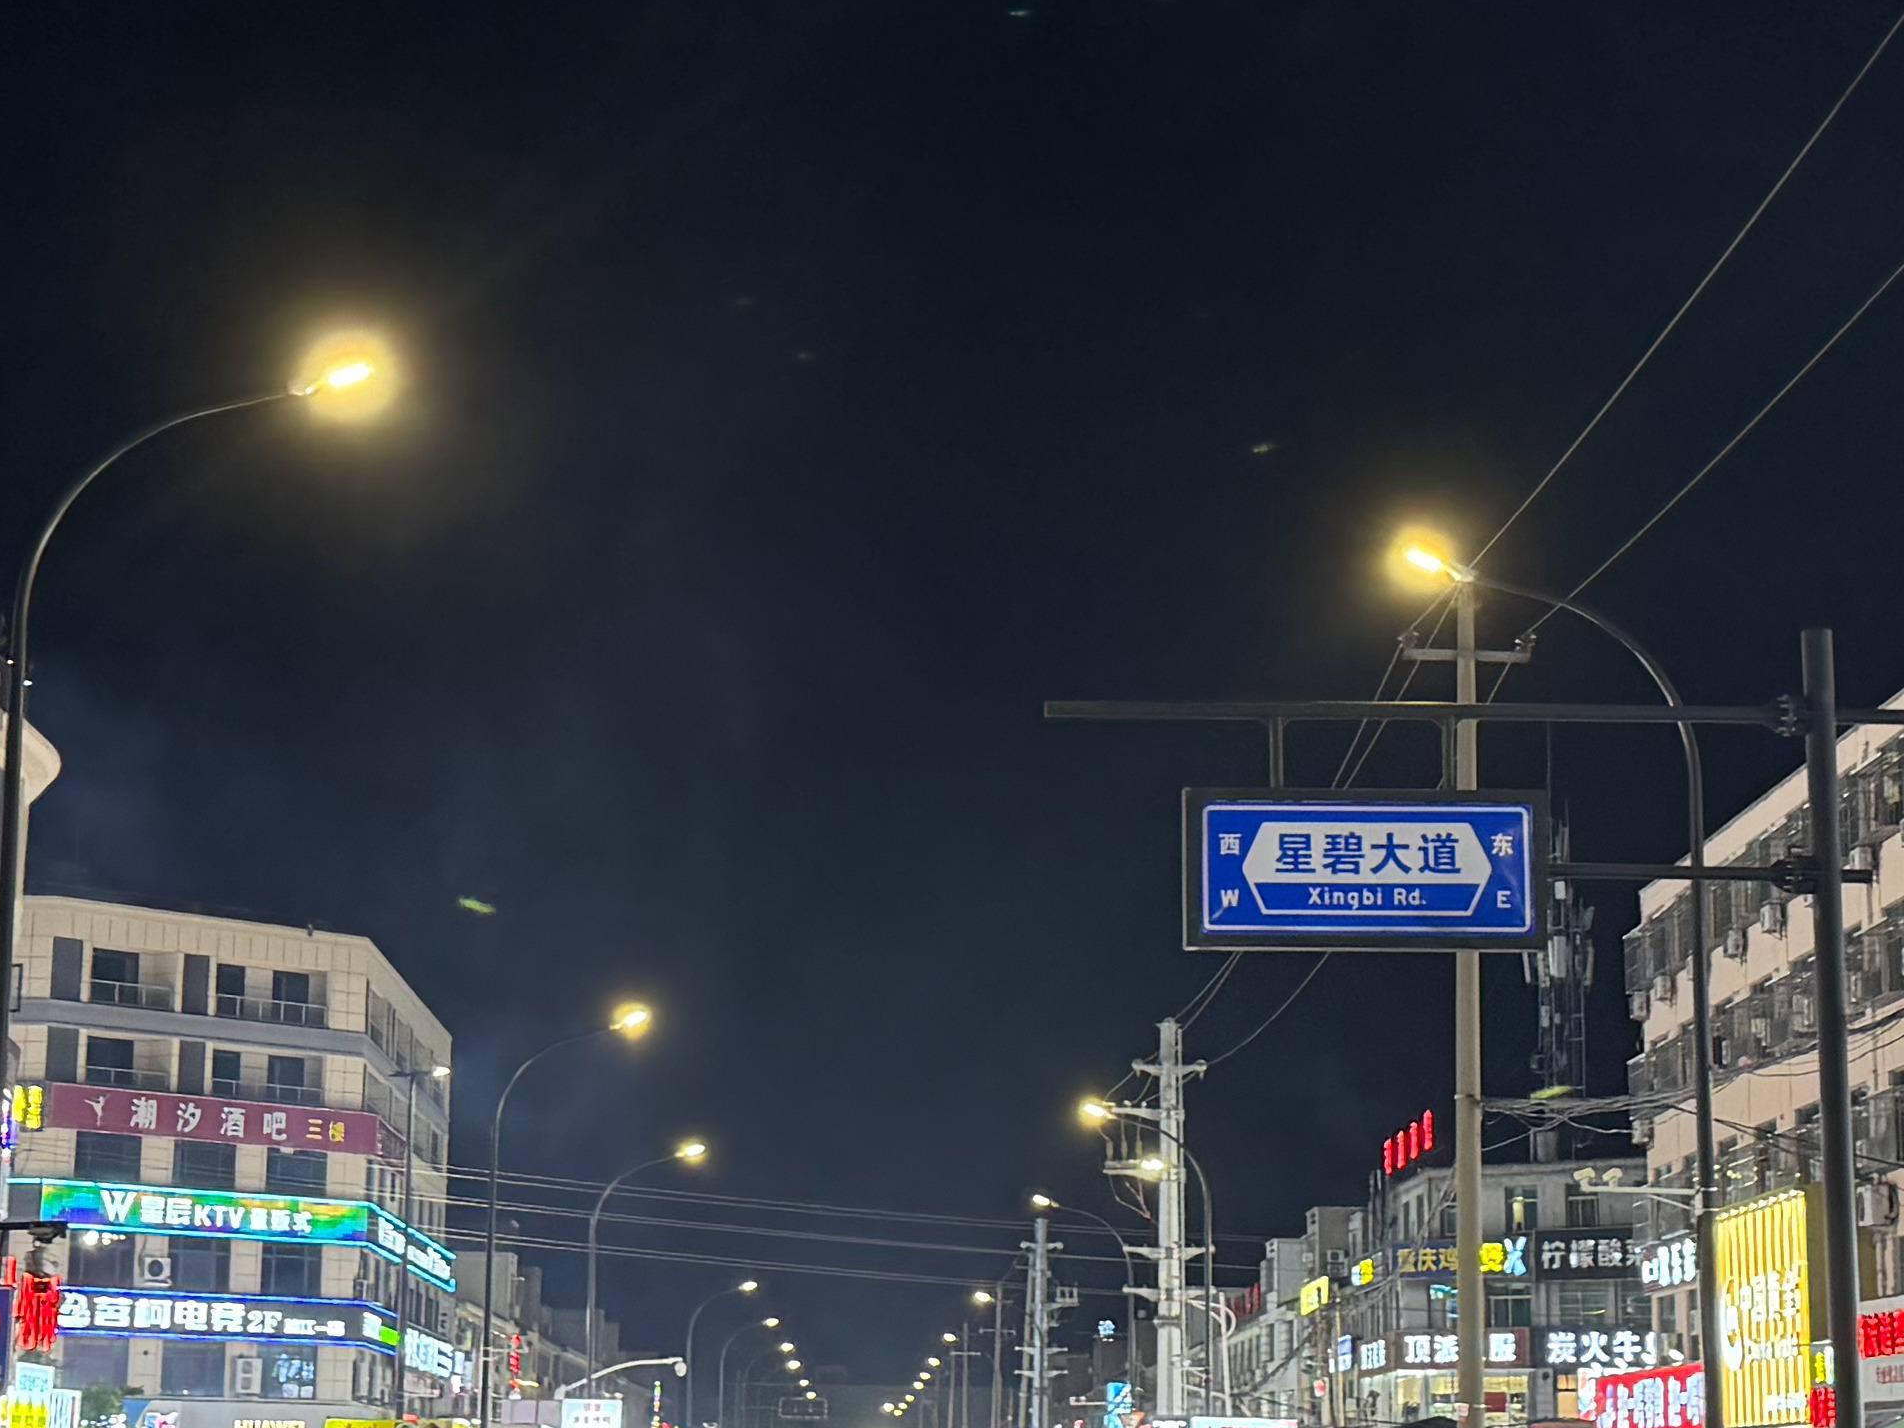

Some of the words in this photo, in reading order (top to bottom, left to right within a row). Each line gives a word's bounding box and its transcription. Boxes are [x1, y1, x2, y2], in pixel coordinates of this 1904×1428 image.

[1218, 833, 1242, 856] 西
[1275, 832, 1462, 876] 星碧大道
[1491, 834, 1514, 857] 东
[1220, 889, 1240, 908] W
[1308, 887, 1383, 910] Xingbi
[1393, 887, 1426, 906] Rd.
[1496, 890, 1512, 908] E
[129, 1095, 288, 1141] 潮汐酒吧
[1397, 1242, 1504, 1273] 重庆鸡煲
